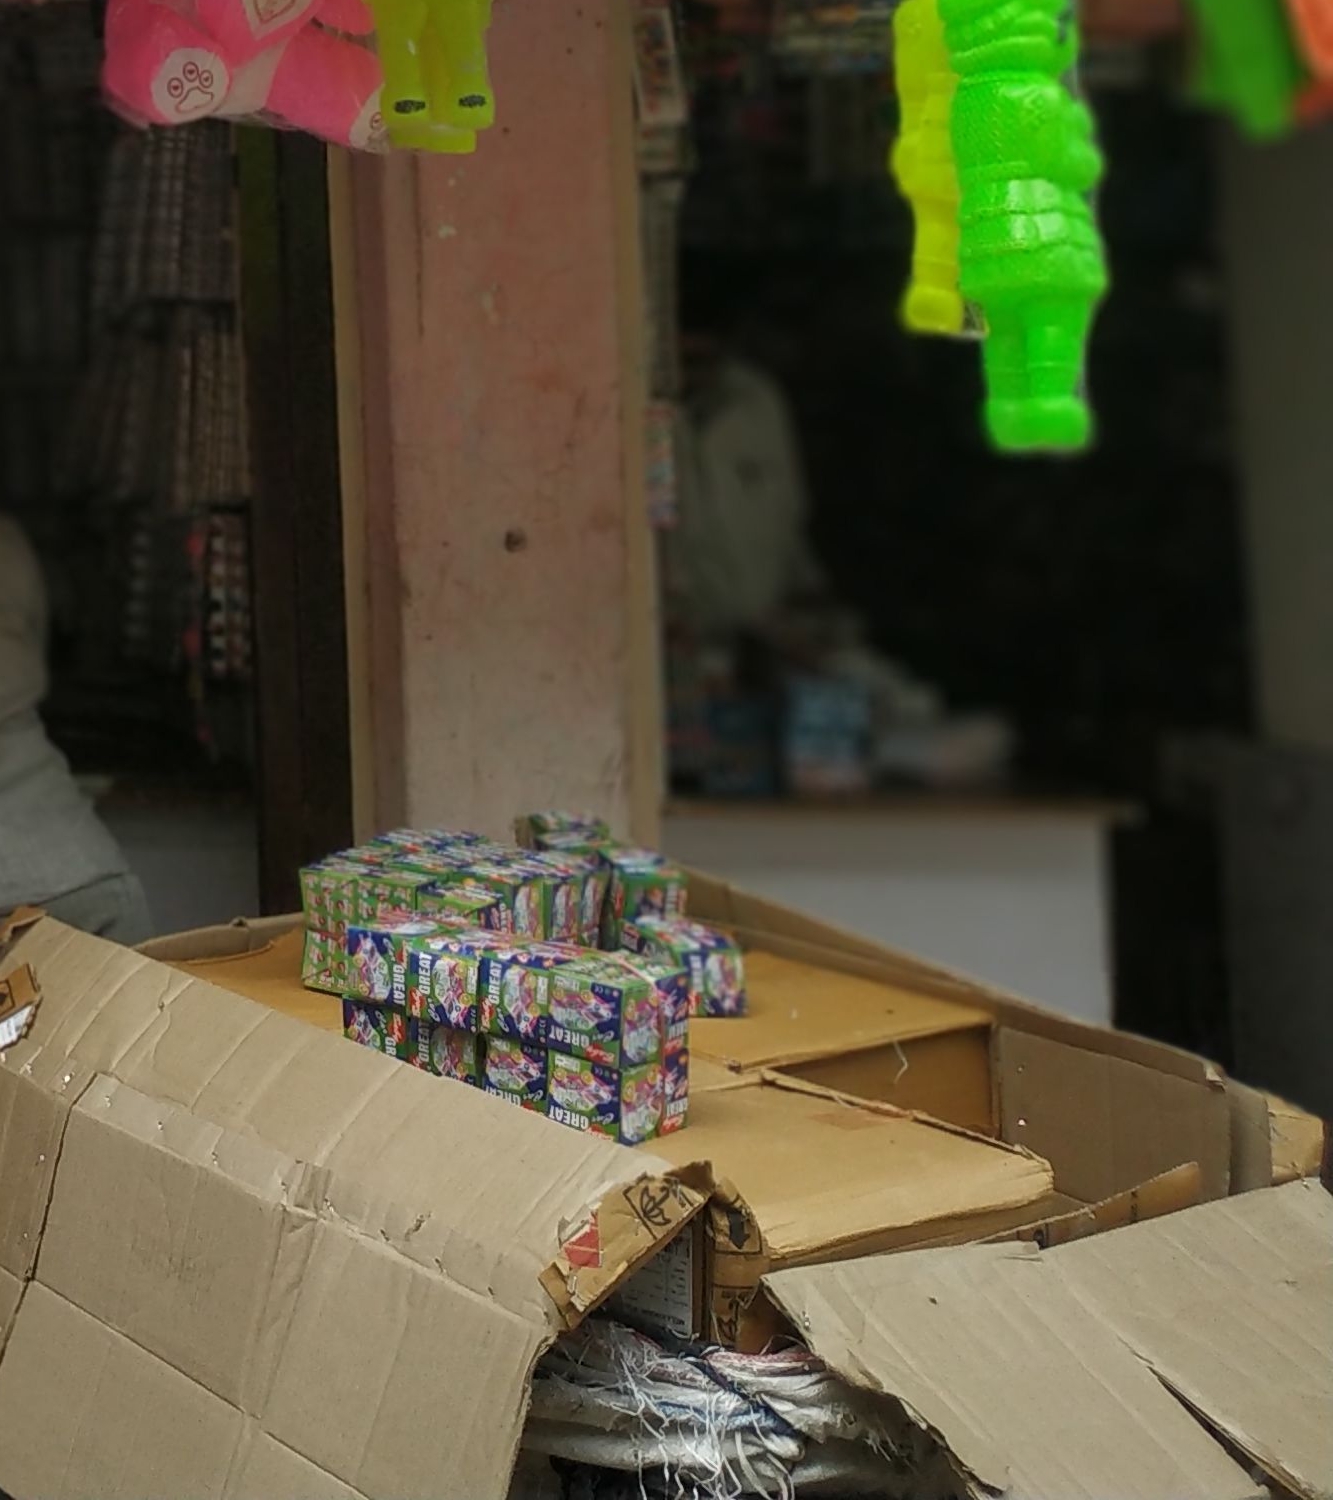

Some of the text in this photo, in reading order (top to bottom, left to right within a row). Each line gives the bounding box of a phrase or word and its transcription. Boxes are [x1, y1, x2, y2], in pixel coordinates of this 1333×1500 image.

[418, 952, 433, 995] GREAT
[488, 960, 502, 1004] GREAT
[549, 1025, 590, 1048] GREAT
[549, 1105, 589, 1129] GREAT
